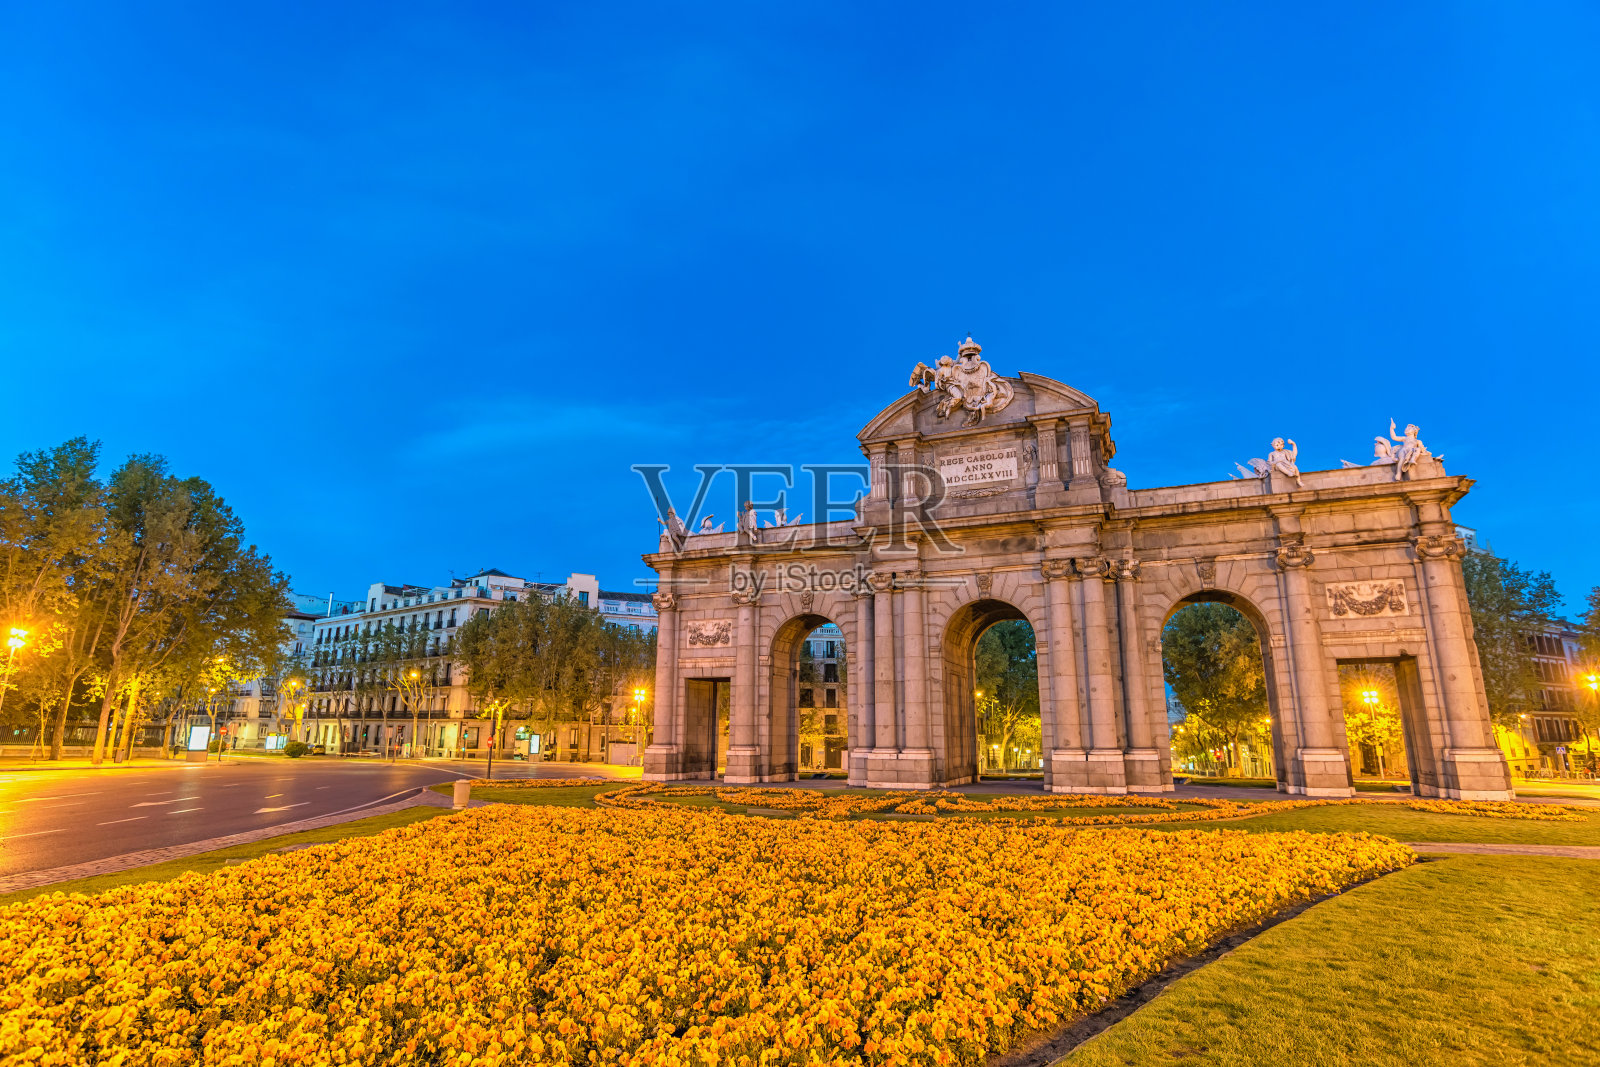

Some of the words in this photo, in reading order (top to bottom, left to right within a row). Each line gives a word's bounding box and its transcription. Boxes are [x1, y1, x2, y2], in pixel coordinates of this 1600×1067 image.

[940, 457, 964, 467] REGE
[966, 452, 1004, 463] CAROLO
[1006, 450, 1017, 459] III
[964, 462, 993, 473] ANNO
[946, 469, 1013, 484] MDCCLXXVIII
